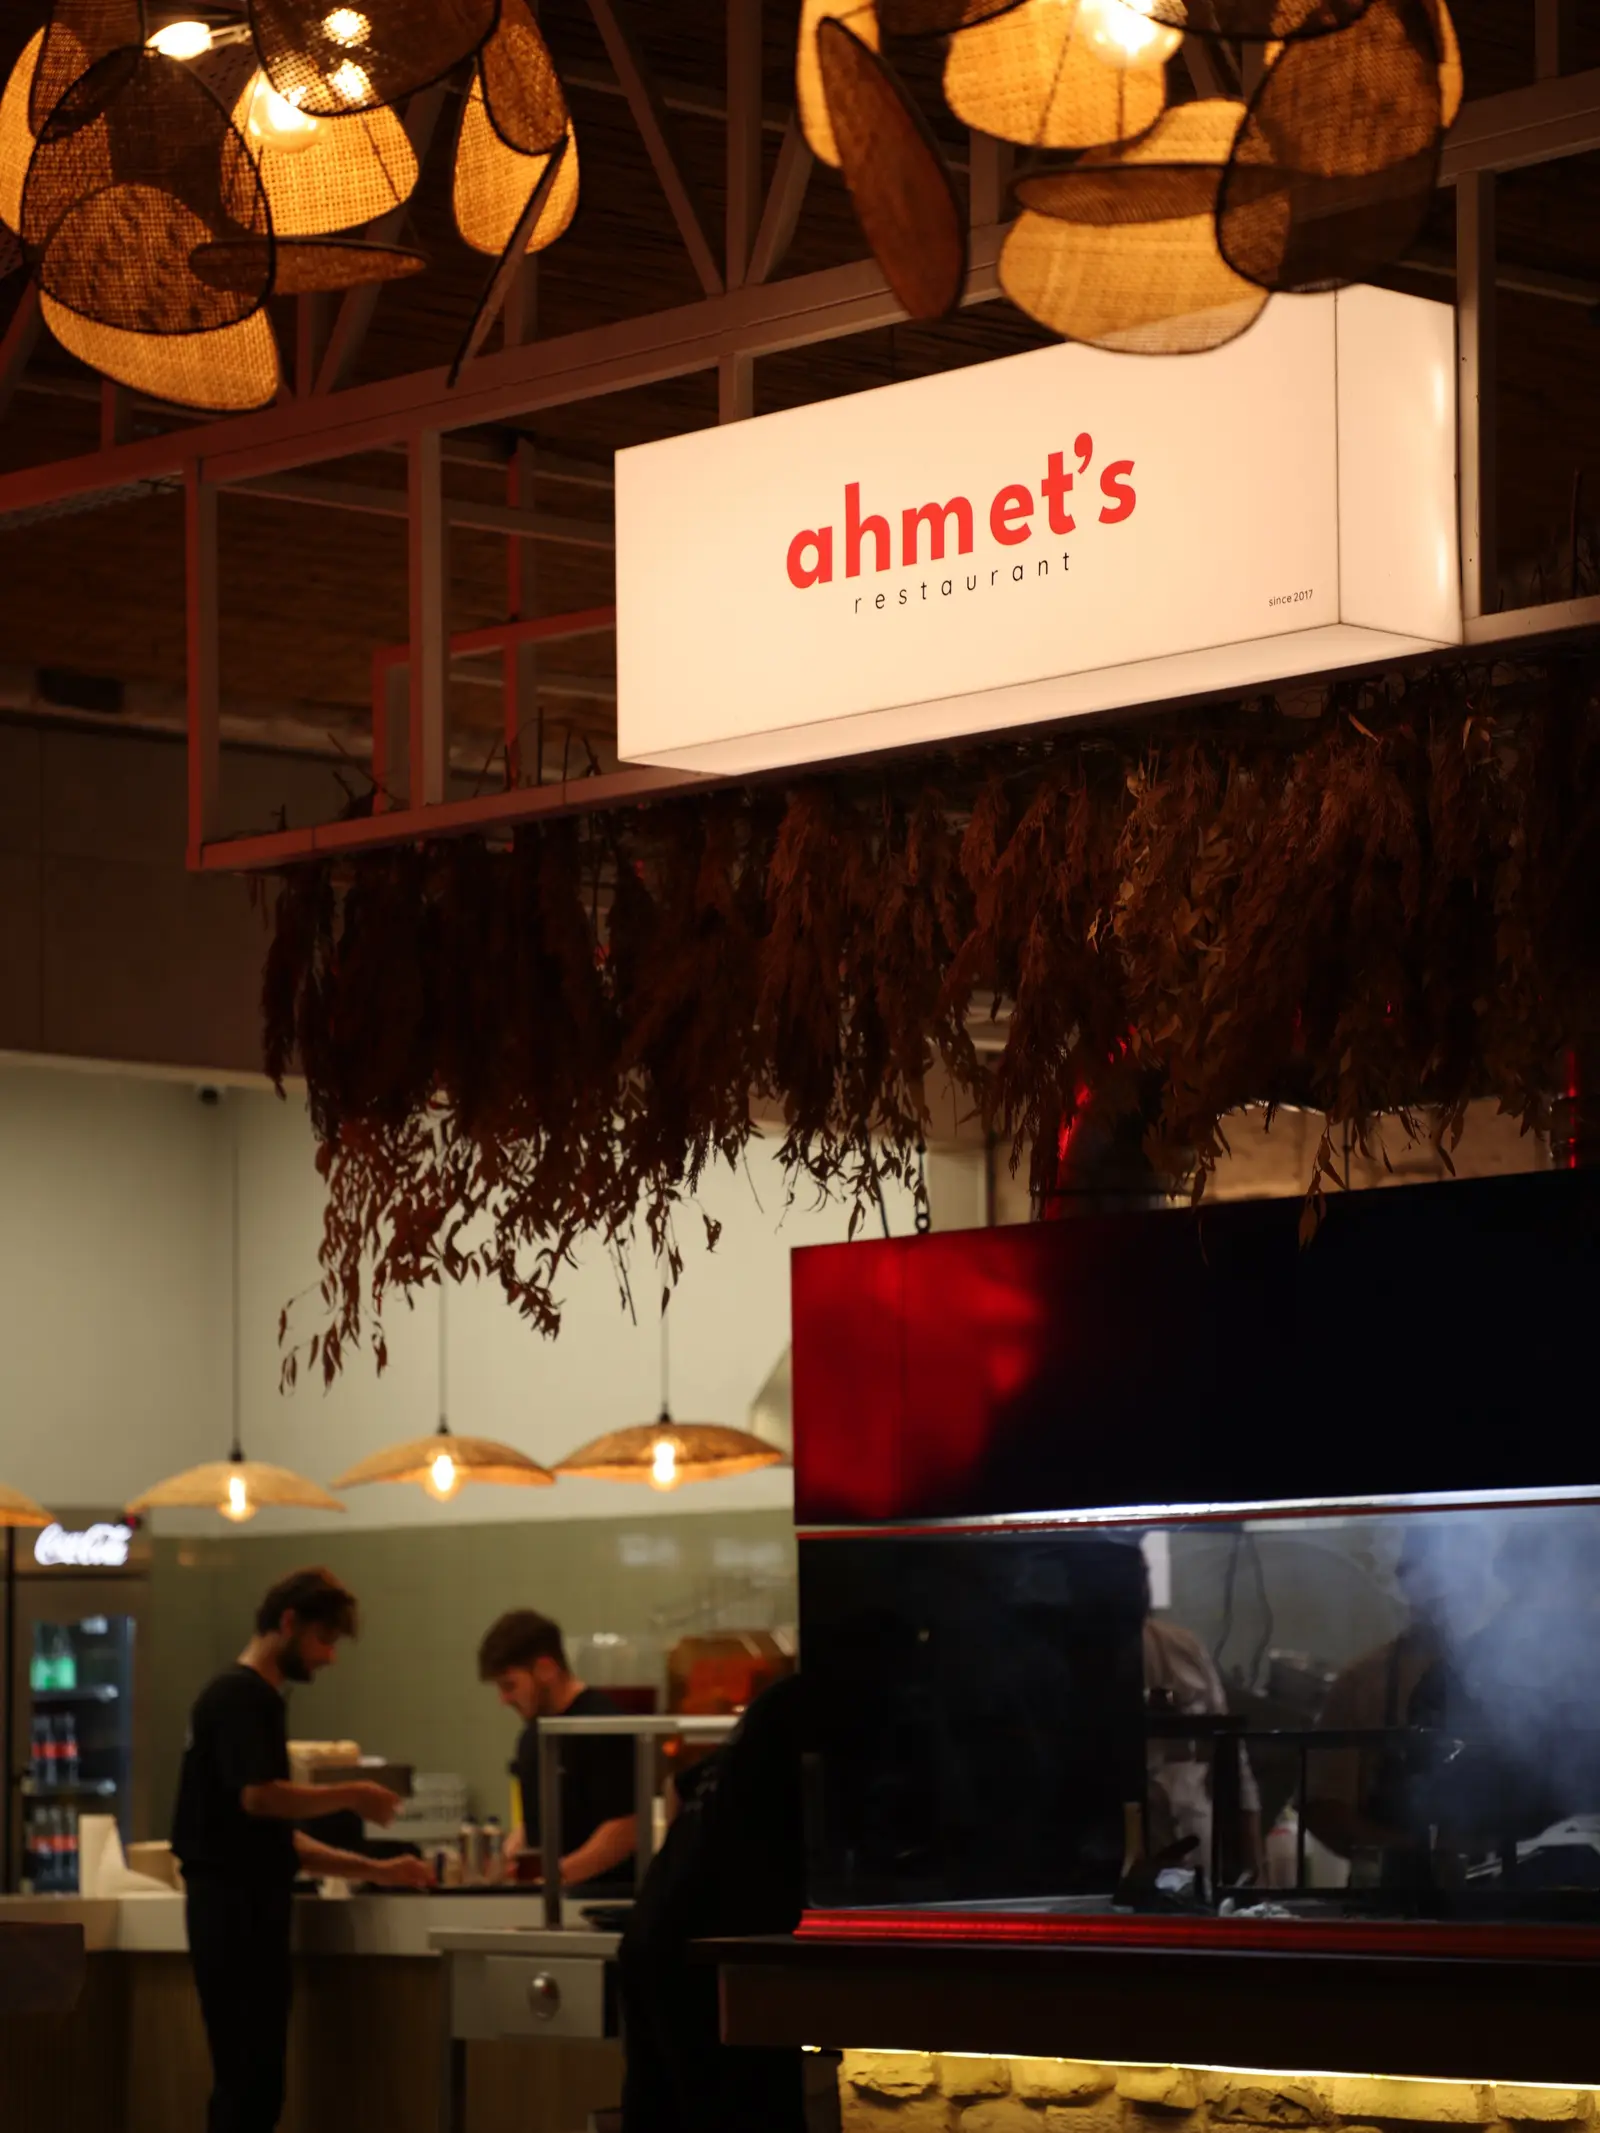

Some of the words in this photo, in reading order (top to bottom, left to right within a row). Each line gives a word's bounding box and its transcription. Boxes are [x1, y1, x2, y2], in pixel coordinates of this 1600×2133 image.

[787, 432, 1136, 589] ahmet’s
[854, 552, 1070, 613] restaurant
[1268, 595, 1292, 607] since
[1293, 588, 1314, 602] 2017
